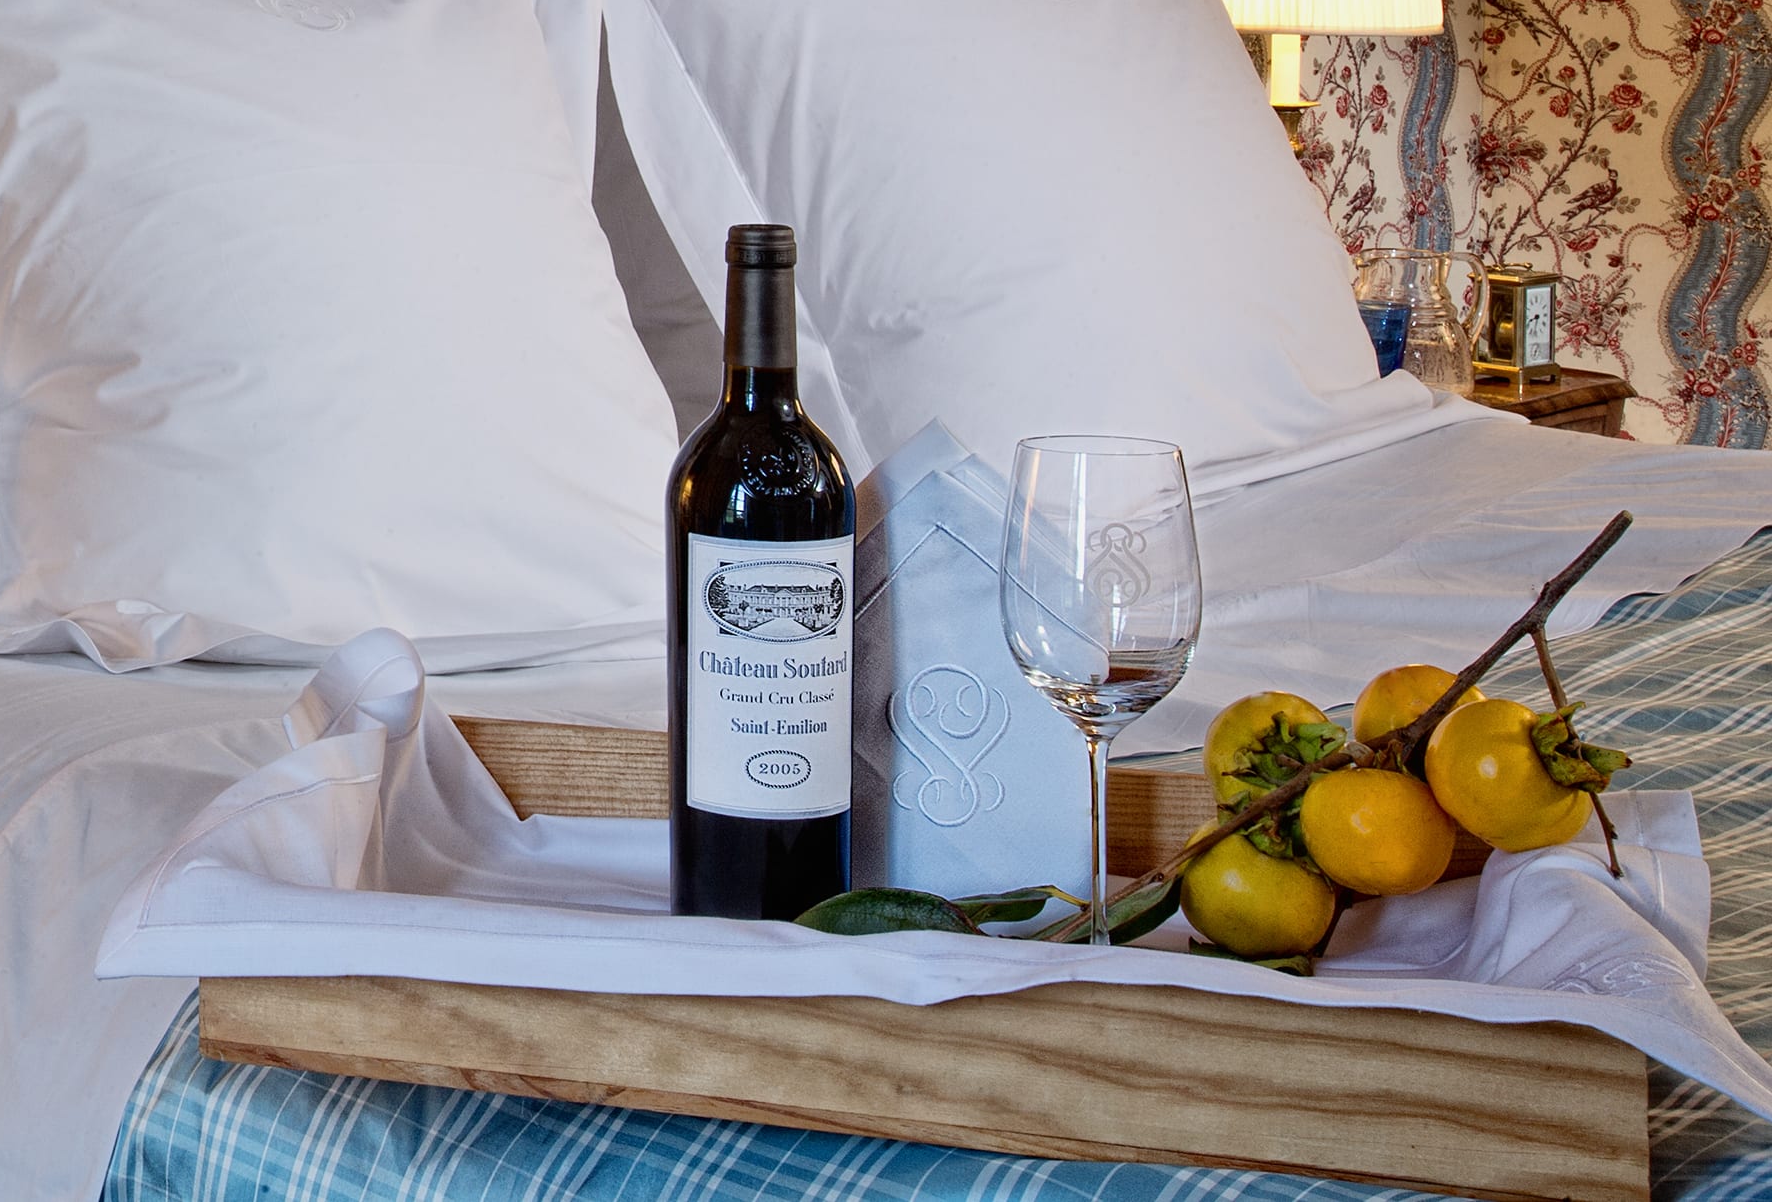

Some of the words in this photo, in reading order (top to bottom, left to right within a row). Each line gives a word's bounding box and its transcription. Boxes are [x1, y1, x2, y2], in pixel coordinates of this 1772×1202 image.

[699, 650, 778, 679] Château
[783, 651, 848, 679] Soutard
[719, 688, 763, 704] Grand
[768, 691, 794, 705] Cru
[799, 688, 835, 705] Classé
[759, 763, 801, 775] 2005
